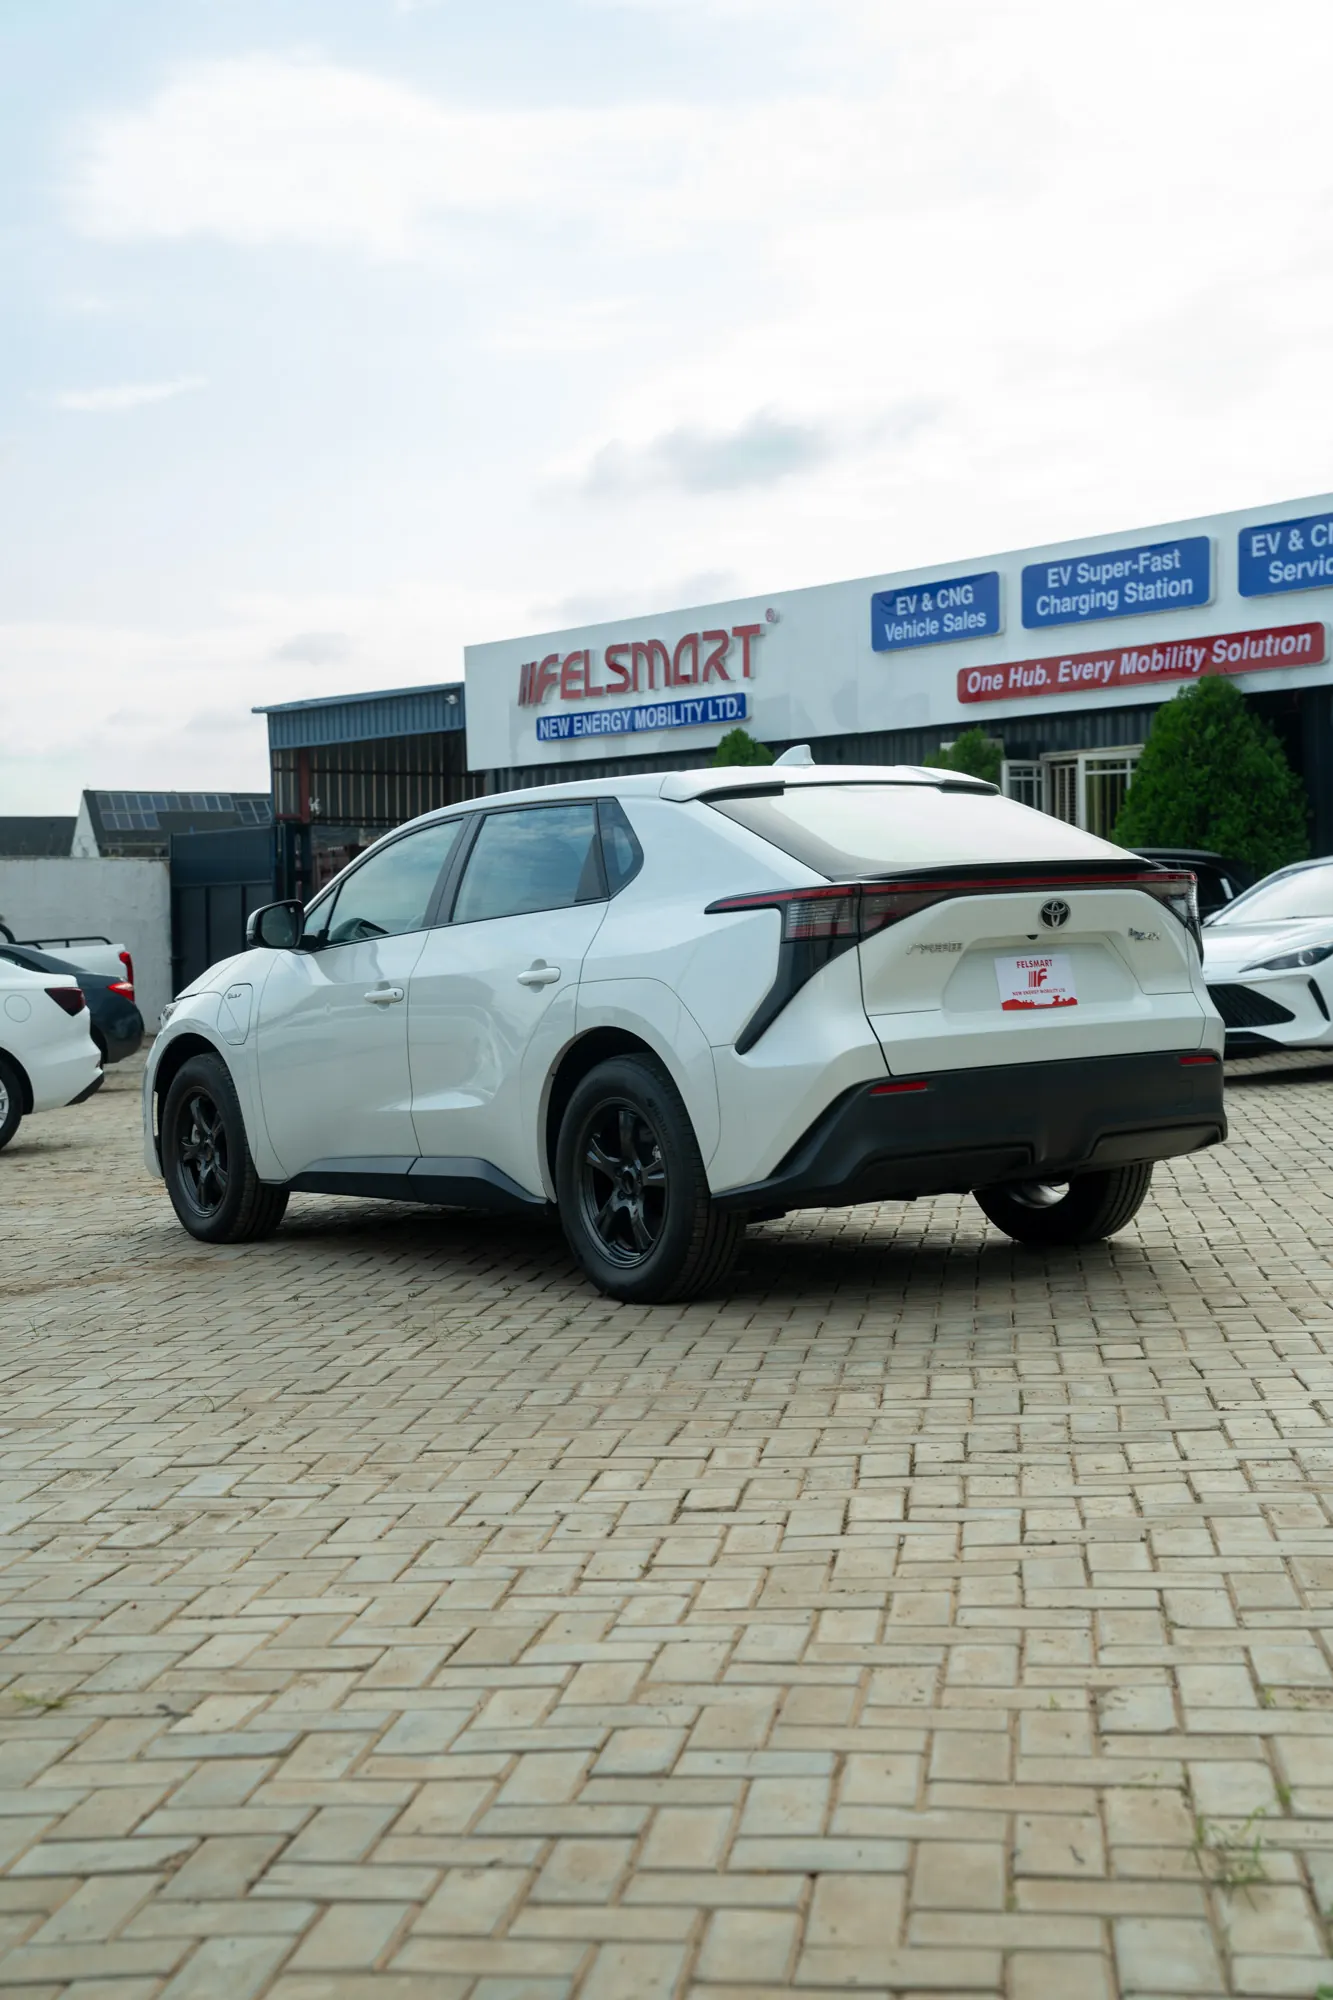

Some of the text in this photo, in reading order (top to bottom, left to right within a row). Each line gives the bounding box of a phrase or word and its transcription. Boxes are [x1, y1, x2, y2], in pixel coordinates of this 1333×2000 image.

[1251, 532, 1281, 557] EV
[1287, 528, 1304, 552] &
[1047, 549, 1181, 588] EV Super-Fast
[896, 584, 974, 616] EV & CNG
[1036, 577, 1193, 616] Charging Station
[884, 610, 987, 642] Vehicle Sales
[534, 624, 761, 705] FELSMART
[967, 633, 1311, 694] One Hub. Every Mobility Solution
[539, 696, 742, 739] NEW ENERGY MOBILITY LTD.
[1016, 959, 1053, 969] FELSMART
